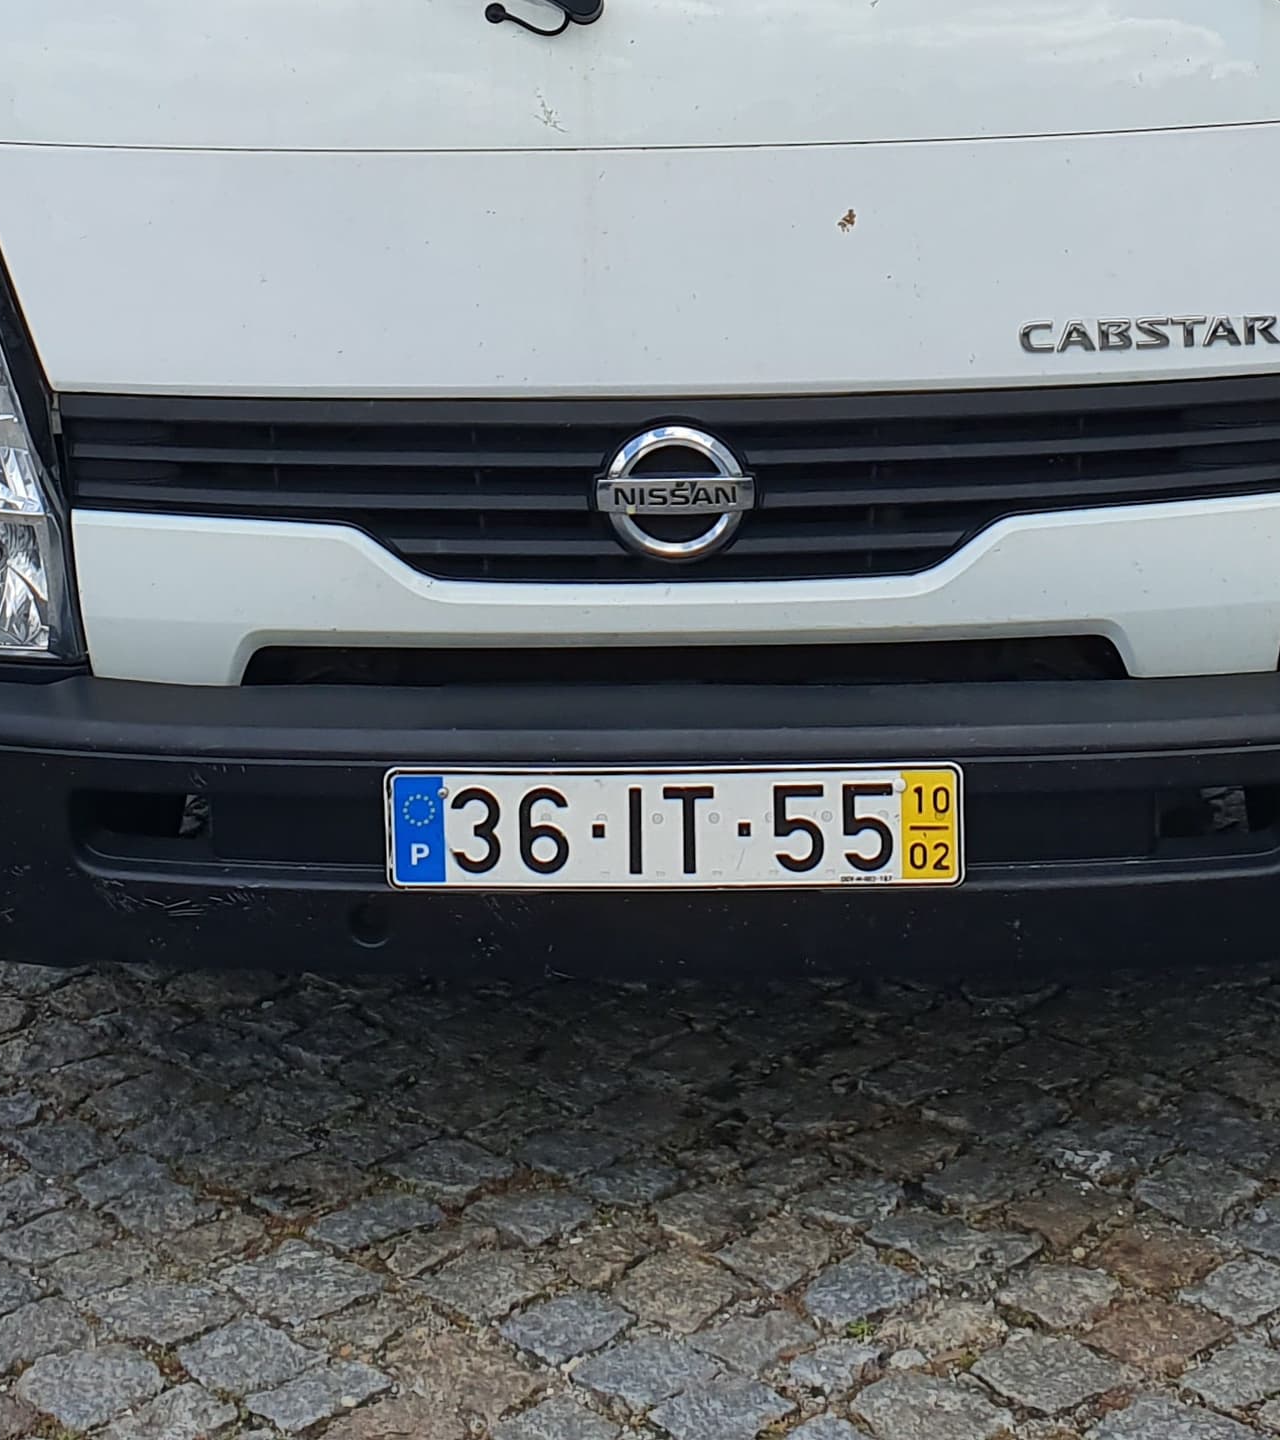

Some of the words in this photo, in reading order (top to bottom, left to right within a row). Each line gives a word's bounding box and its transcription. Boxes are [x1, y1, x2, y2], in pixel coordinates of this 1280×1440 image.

[1018, 314, 1280, 353] CABSTAR
[613, 485, 737, 506] NISSAN
[912, 786, 950, 814] 10
[410, 843, 430, 866] P
[909, 842, 950, 871] 02
